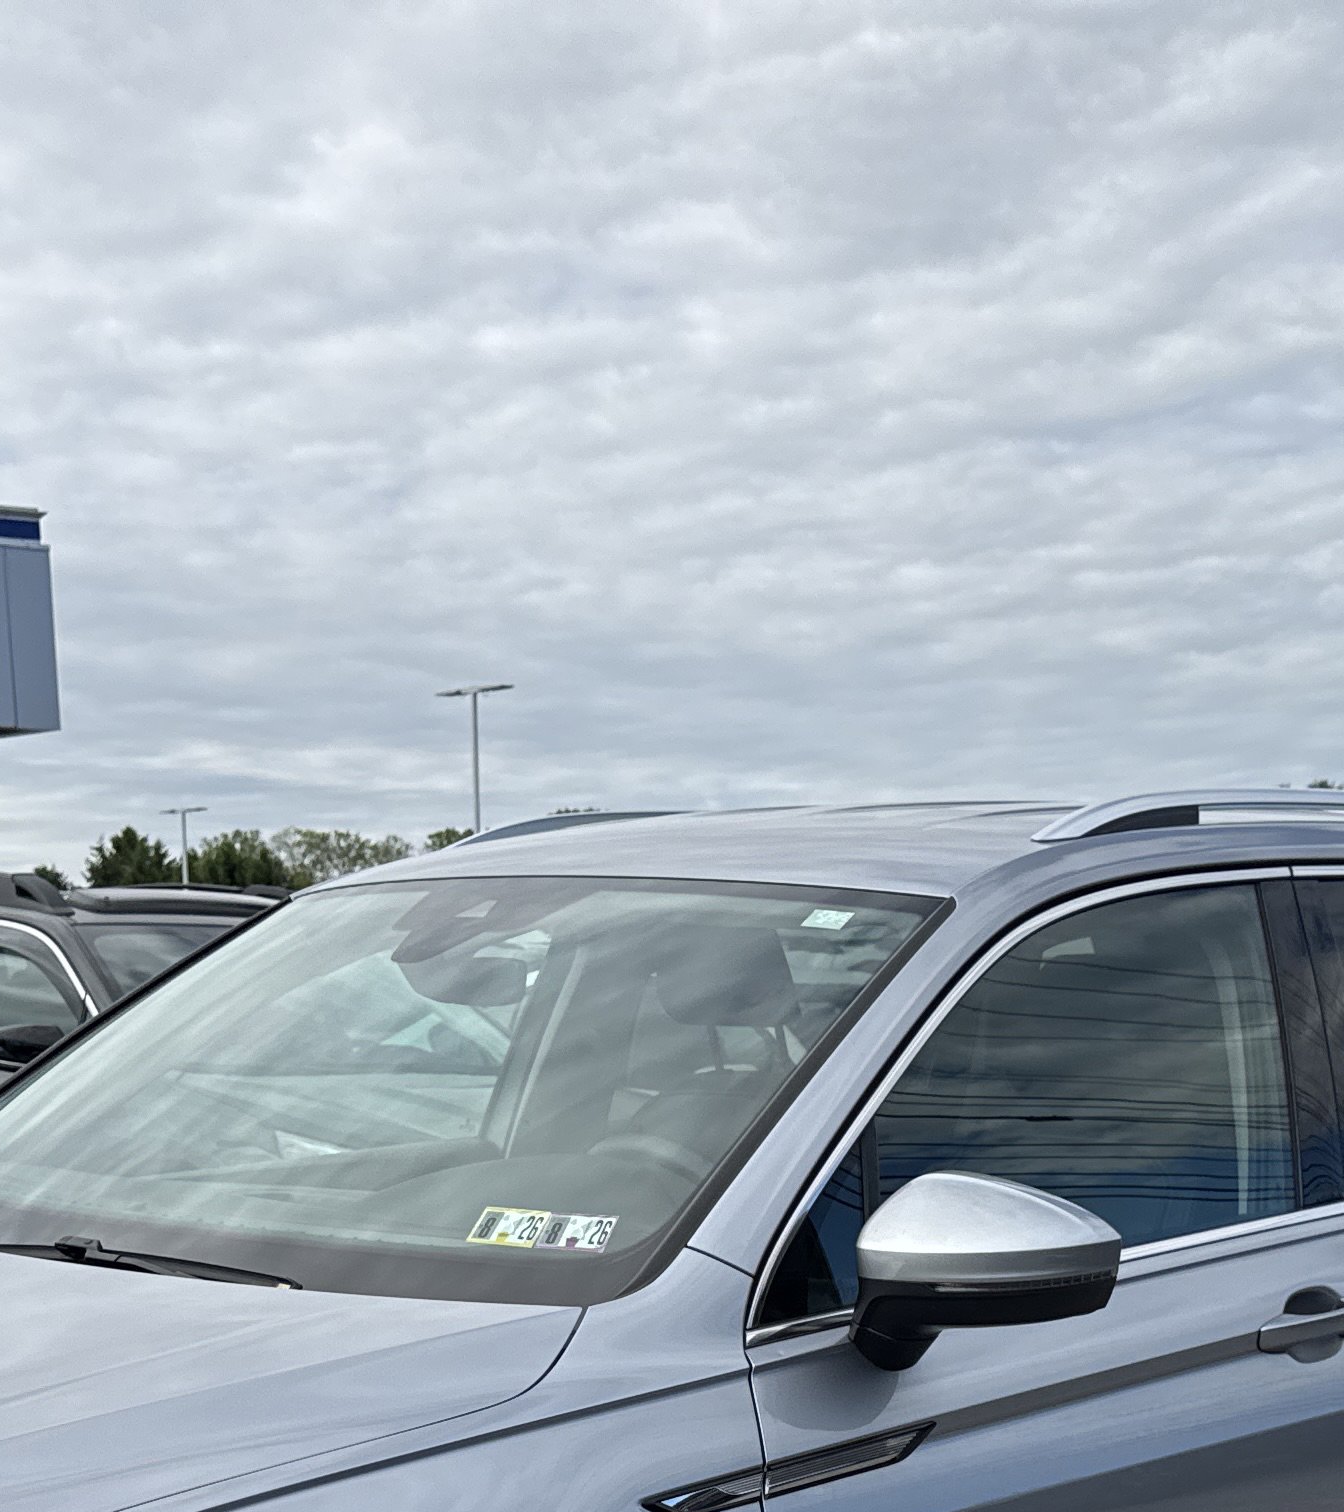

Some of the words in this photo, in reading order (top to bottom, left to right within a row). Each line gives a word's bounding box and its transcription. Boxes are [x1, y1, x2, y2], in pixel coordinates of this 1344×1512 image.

[478, 1217, 497, 1239] 8
[517, 1215, 544, 1241] 26
[545, 1222, 563, 1245] 8
[587, 1219, 613, 1246] 26
